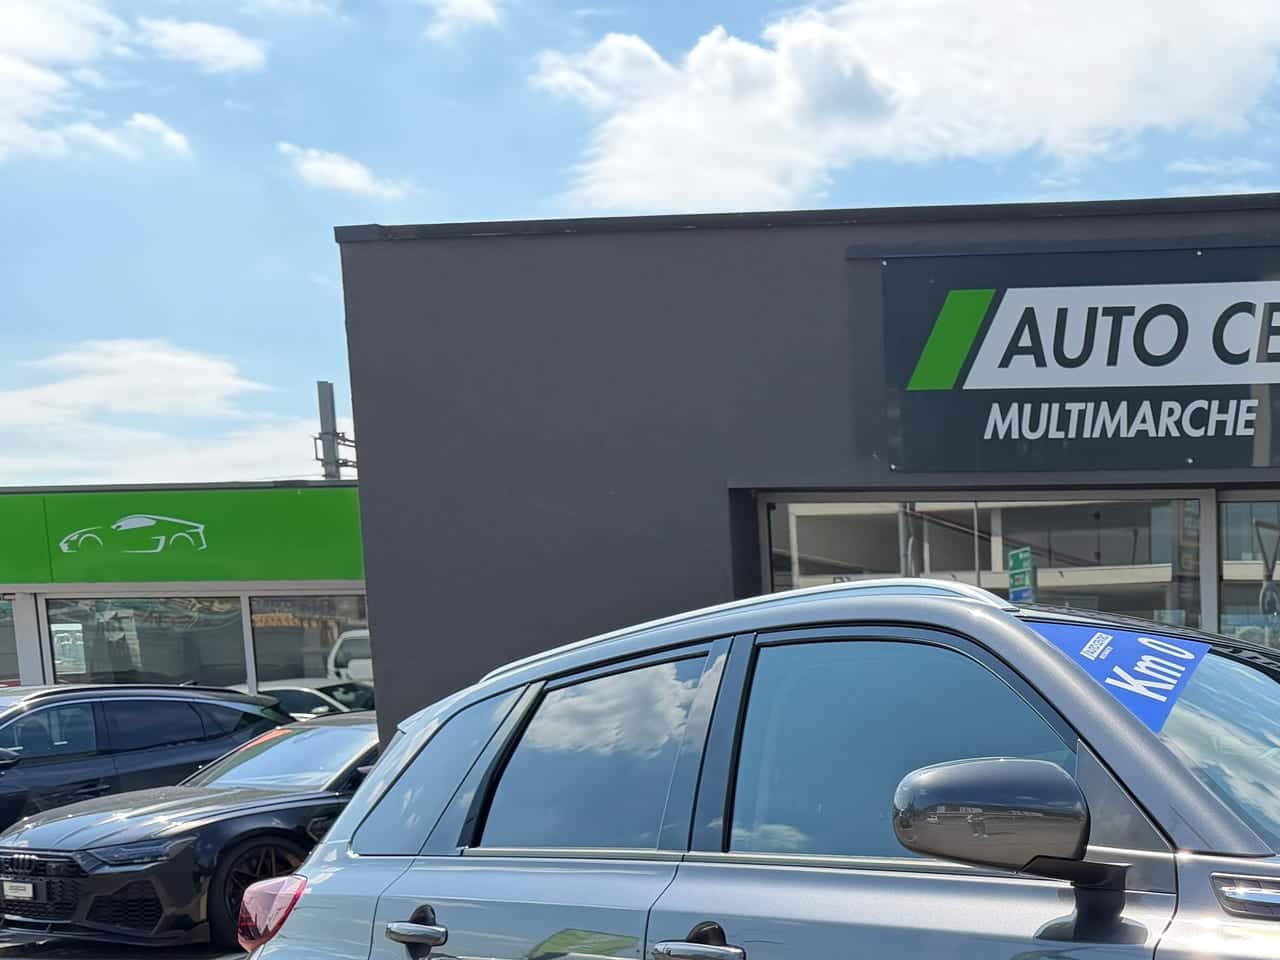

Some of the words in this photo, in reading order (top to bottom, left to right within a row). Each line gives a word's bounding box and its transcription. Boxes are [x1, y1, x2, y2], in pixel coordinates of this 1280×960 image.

[998, 303, 1189, 369] AUTO
[984, 400, 1258, 440] MULTIMARCHE
[1104, 655, 1186, 703] Km
